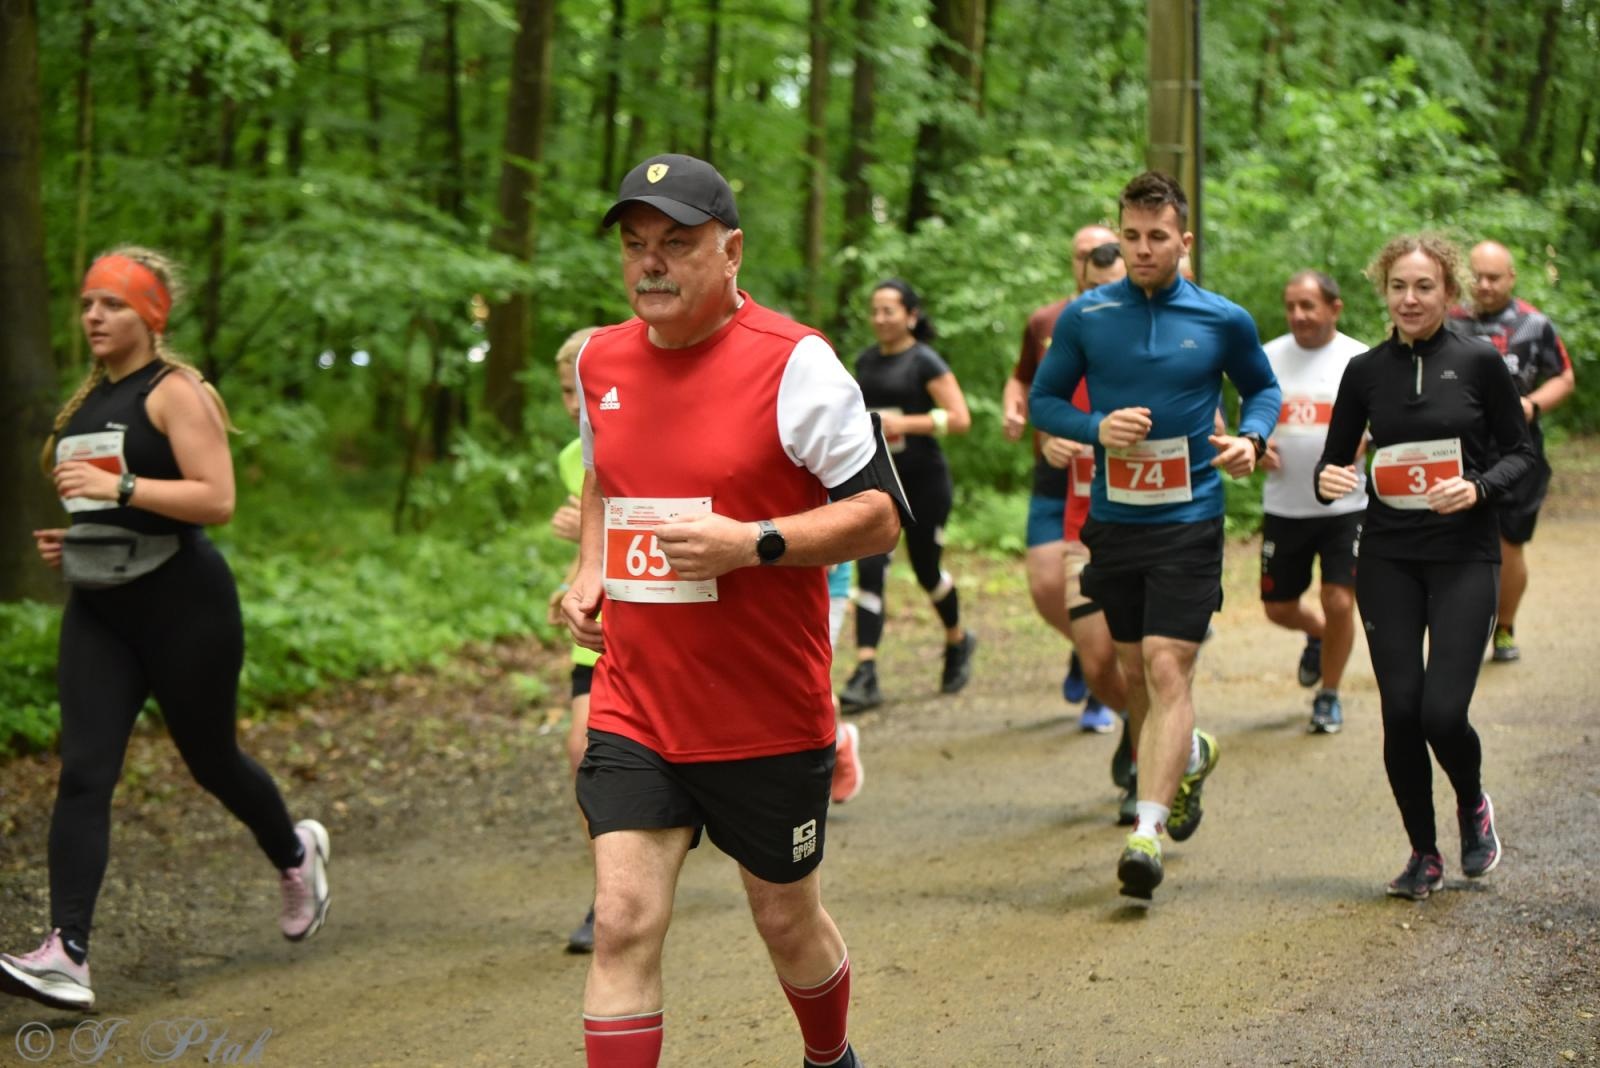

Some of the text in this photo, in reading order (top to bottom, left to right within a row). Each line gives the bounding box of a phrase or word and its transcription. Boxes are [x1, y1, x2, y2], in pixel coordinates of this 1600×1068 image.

[600, 402, 620, 410] adidas
[1288, 400, 1317, 425] 20
[1126, 462, 1166, 489] 74
[1407, 465, 1428, 494] 3
[626, 534, 672, 577] 65
